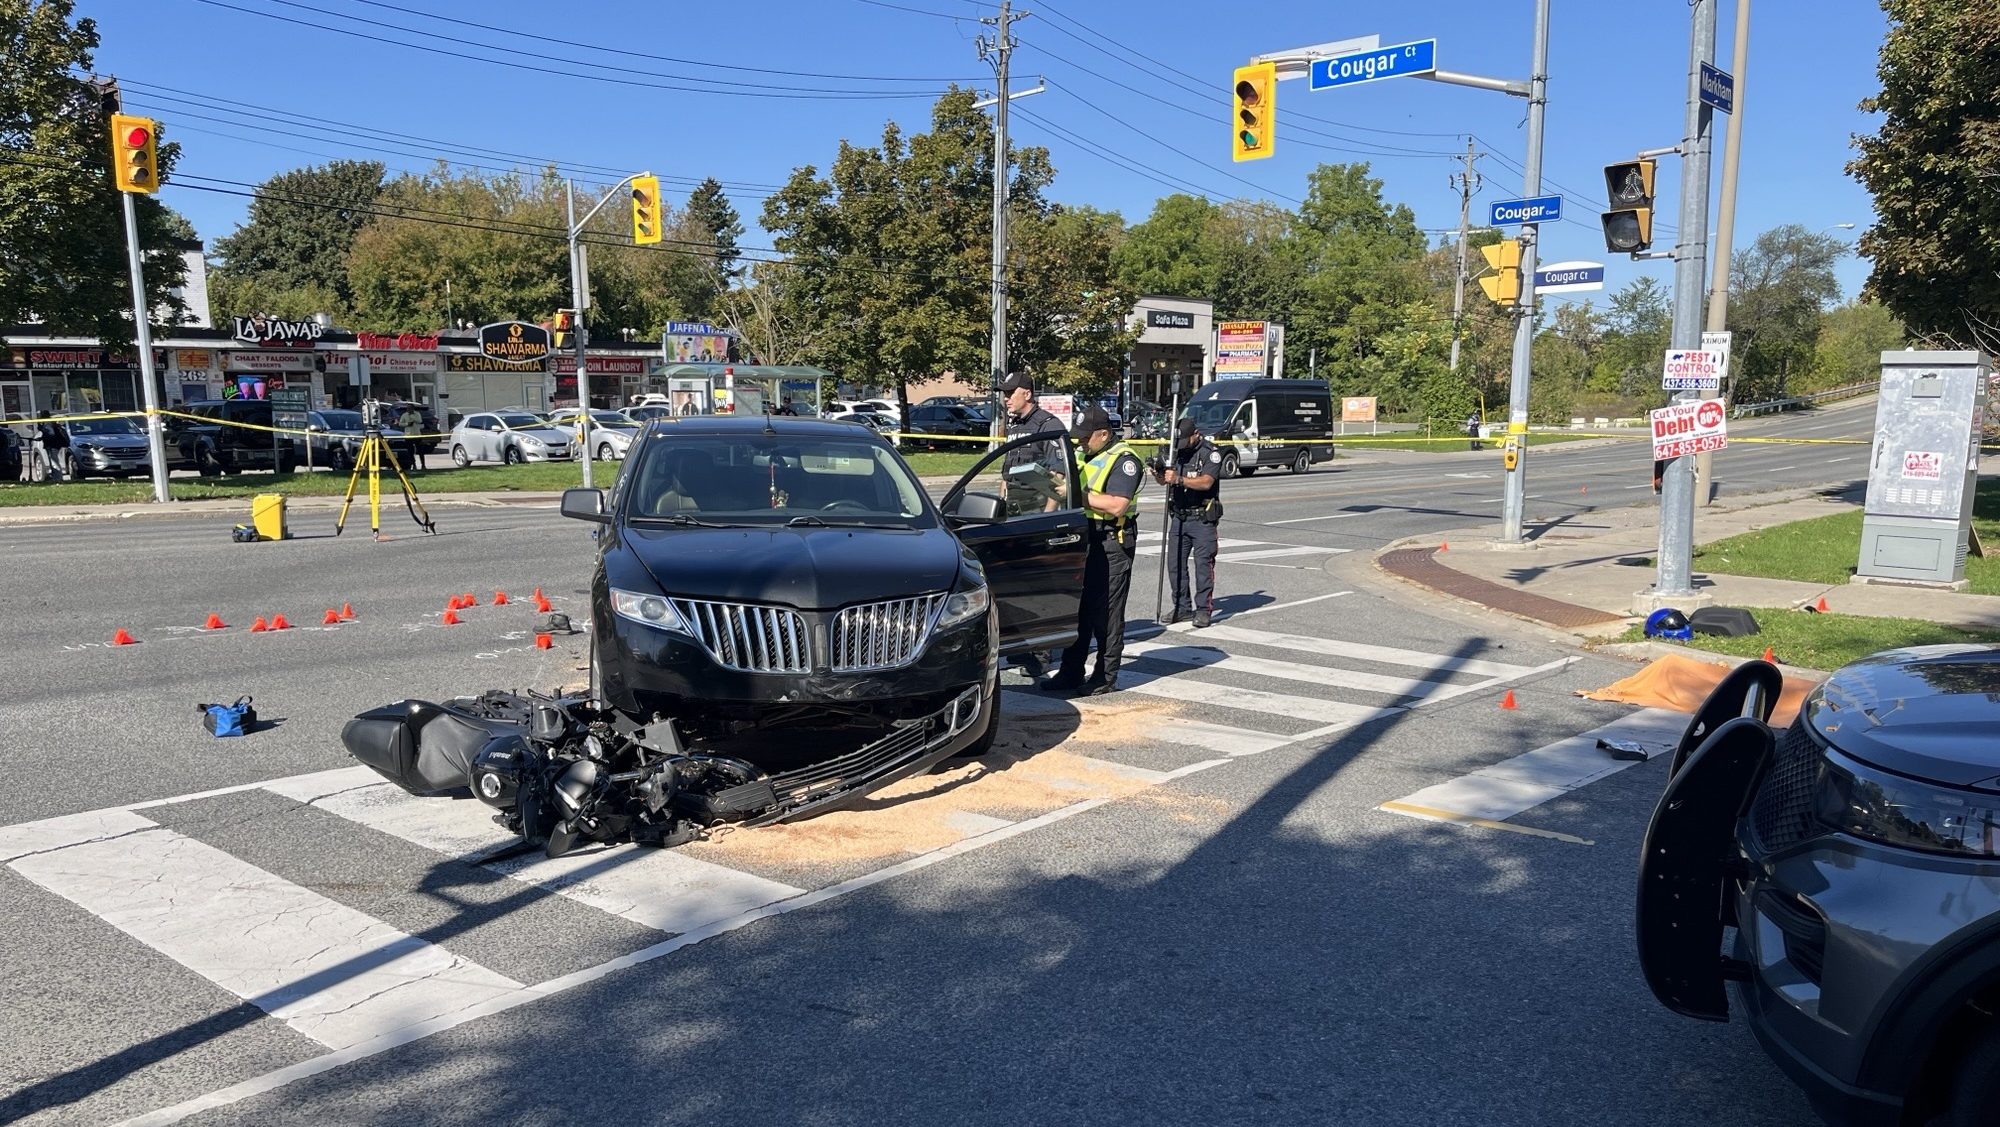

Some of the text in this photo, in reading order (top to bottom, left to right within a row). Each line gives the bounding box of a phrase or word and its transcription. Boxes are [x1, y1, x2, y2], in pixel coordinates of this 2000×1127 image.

[1327, 45, 1417, 79] Cougar Ct
[1701, 70, 1732, 102] Markham
[1494, 205, 1545, 220] Cougar
[1545, 271, 1588, 284] Cougar Ct
[1155, 314, 1189, 326] Safa Plaza
[1246, 322, 1263, 330] PLAZA
[233, 316, 322, 342] LA JAWAB
[672, 322, 705, 335] JAFFNA
[357, 332, 439, 350] Tim Choi
[1702, 337, 1728, 345] AXIMUM
[485, 342, 547, 355] SHAWARMA
[30, 350, 102, 364] SWEET
[265, 355, 300, 363] FALOODA
[1684, 352, 1710, 363] PEST
[466, 357, 542, 372] SHAWARMA
[602, 359, 641, 372] LAUNDRY
[1667, 362, 1717, 374] CONTROL
[179, 370, 208, 381] 262
[1652, 406, 1696, 420] Cut Your
[1699, 410, 1721, 426] 80%
[1654, 415, 1696, 438] Debt
[1655, 434, 1727, 459] 647-853-0573
